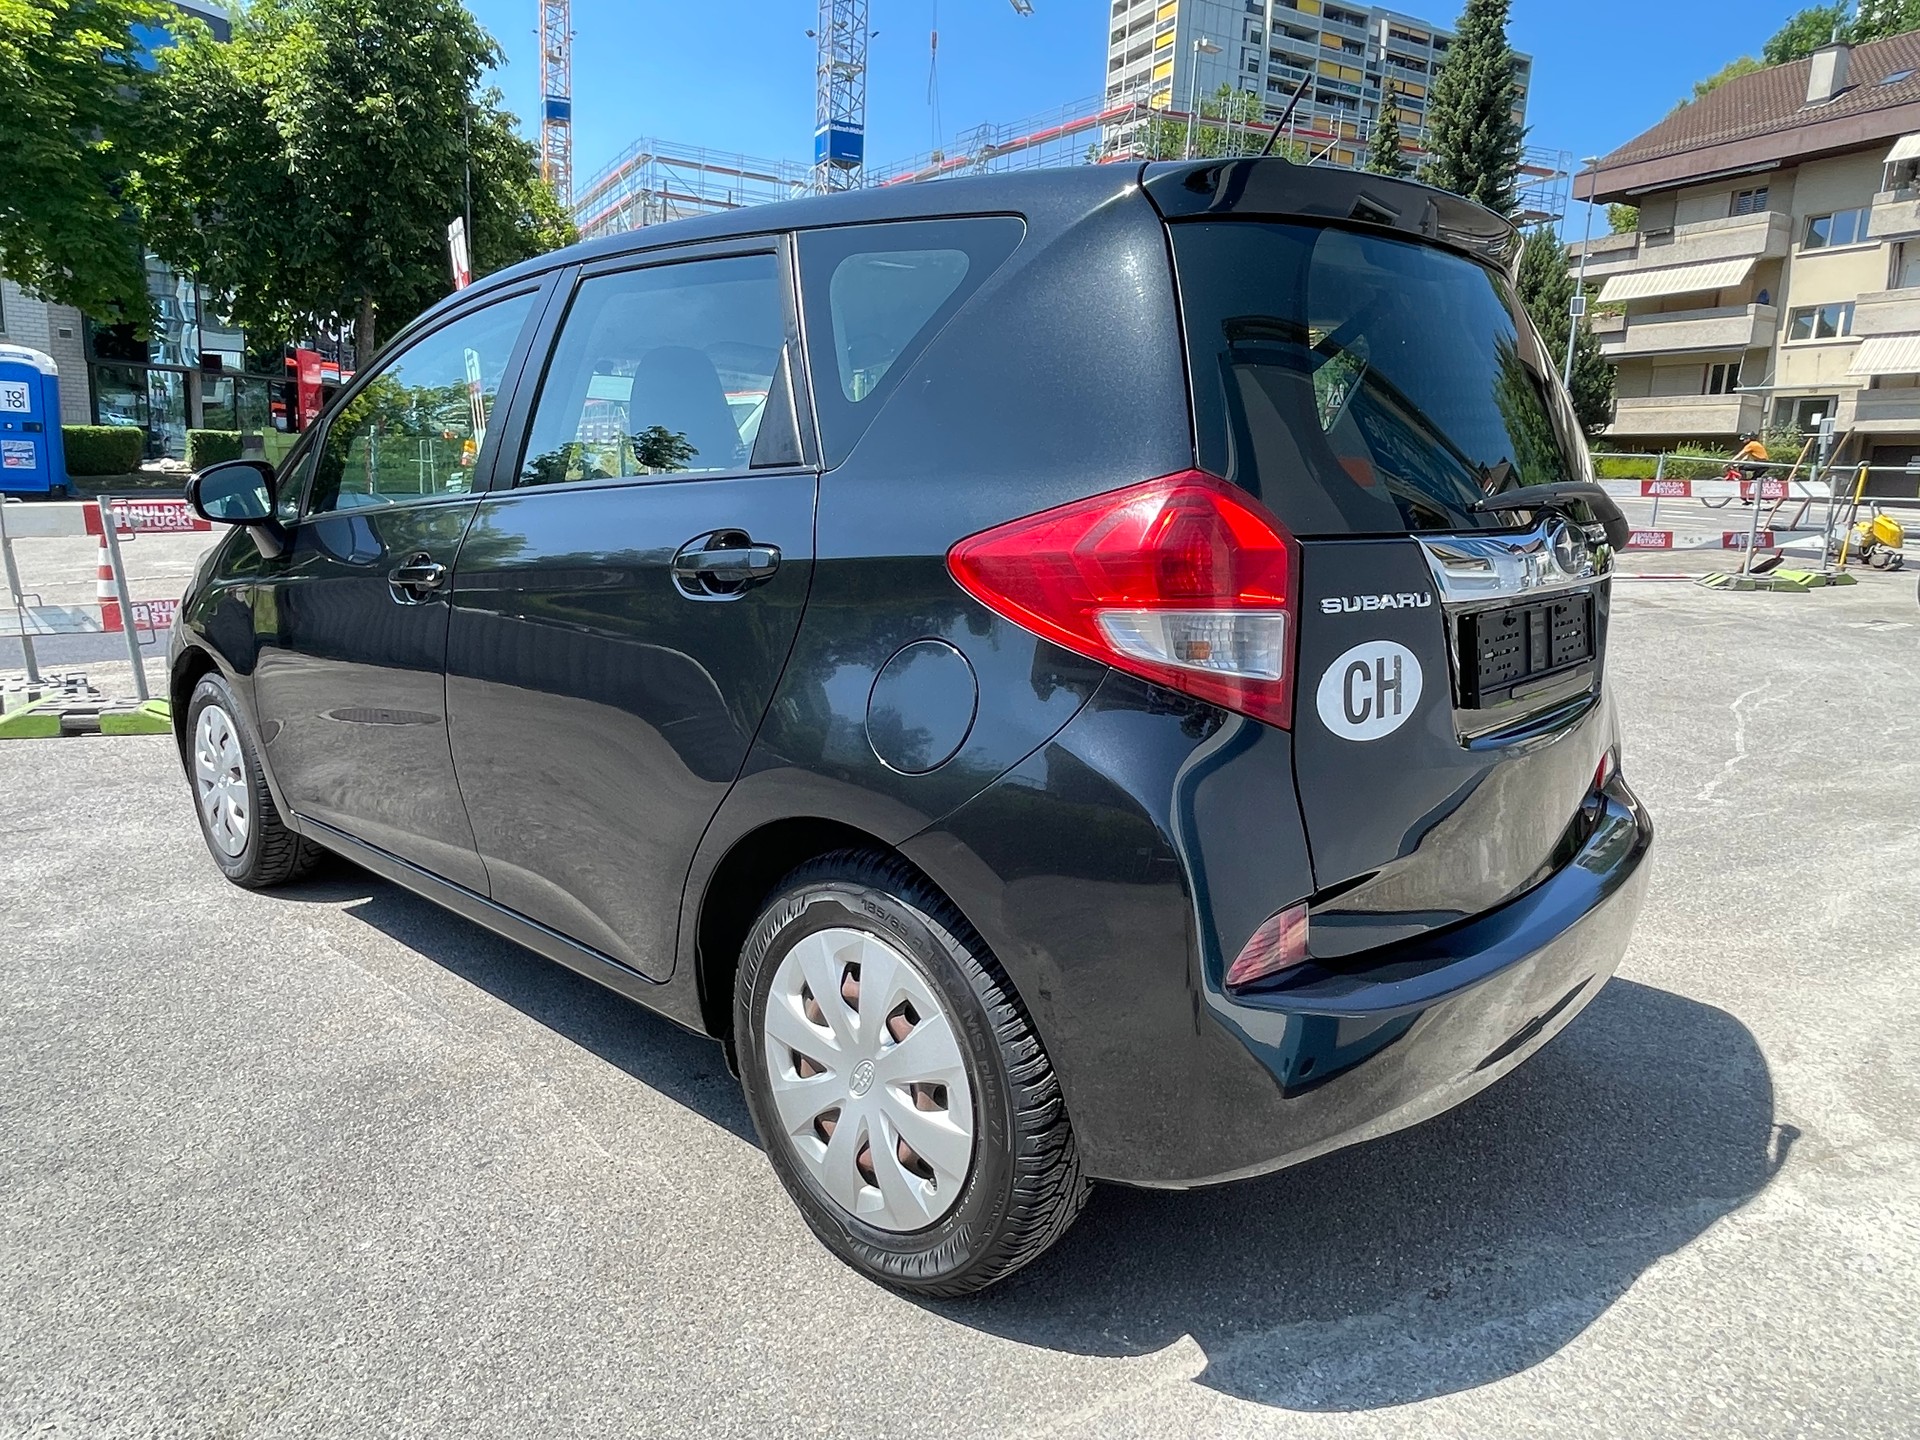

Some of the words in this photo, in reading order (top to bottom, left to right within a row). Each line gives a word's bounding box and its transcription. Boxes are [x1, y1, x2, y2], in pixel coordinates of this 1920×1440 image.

[5, 399, 26, 409] TOI
[142, 515, 195, 527] TUCKI
[1320, 592, 1432, 614] SUBARU
[1343, 654, 1402, 725] CH
